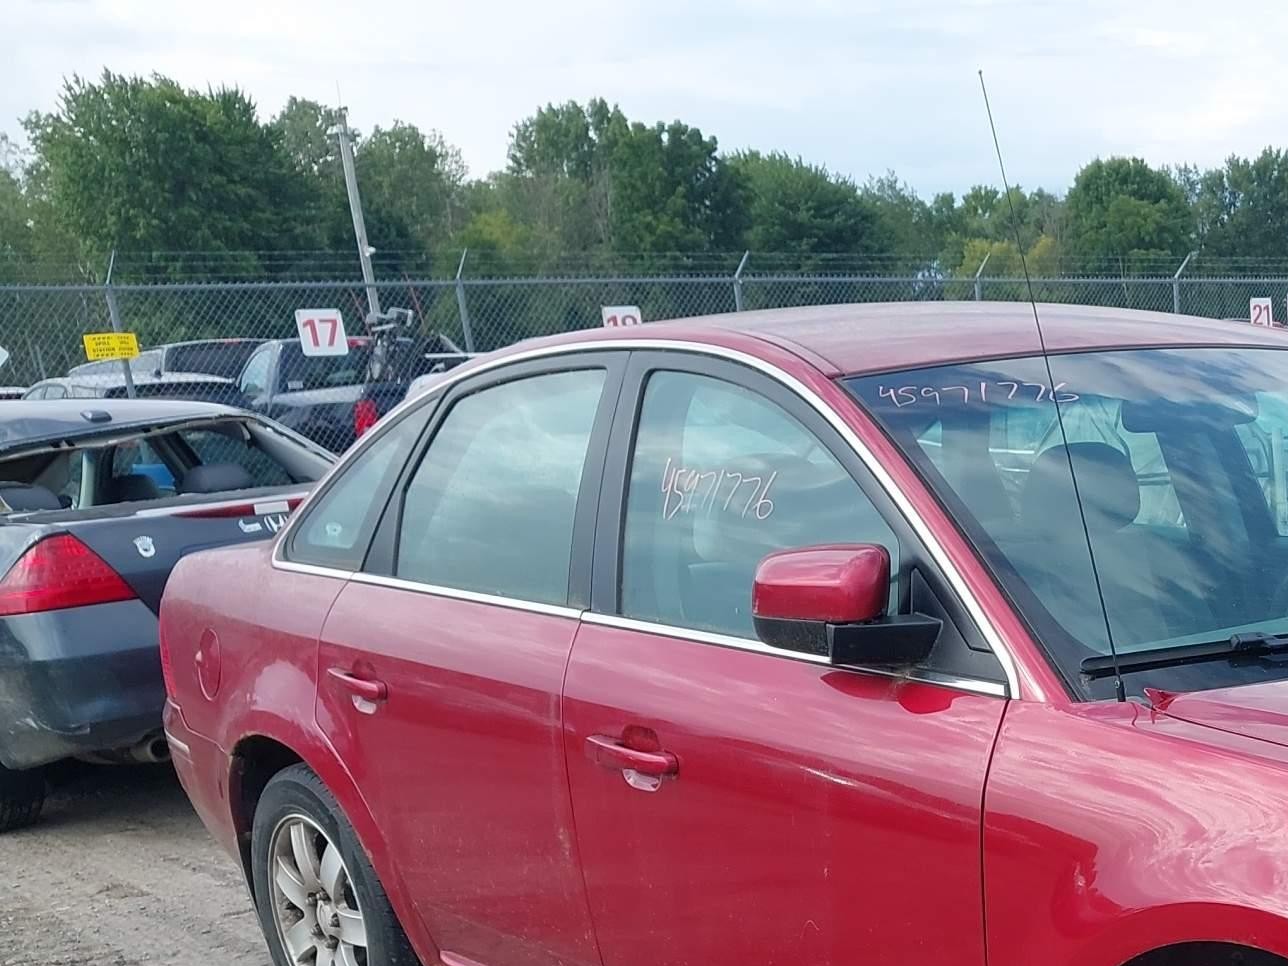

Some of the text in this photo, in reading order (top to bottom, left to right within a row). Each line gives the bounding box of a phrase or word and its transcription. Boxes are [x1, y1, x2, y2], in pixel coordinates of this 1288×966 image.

[1252, 303, 1271, 328] 21
[302, 318, 338, 348] 17
[878, 381, 1080, 408] 45971776
[661, 457, 776, 520] 45971776
